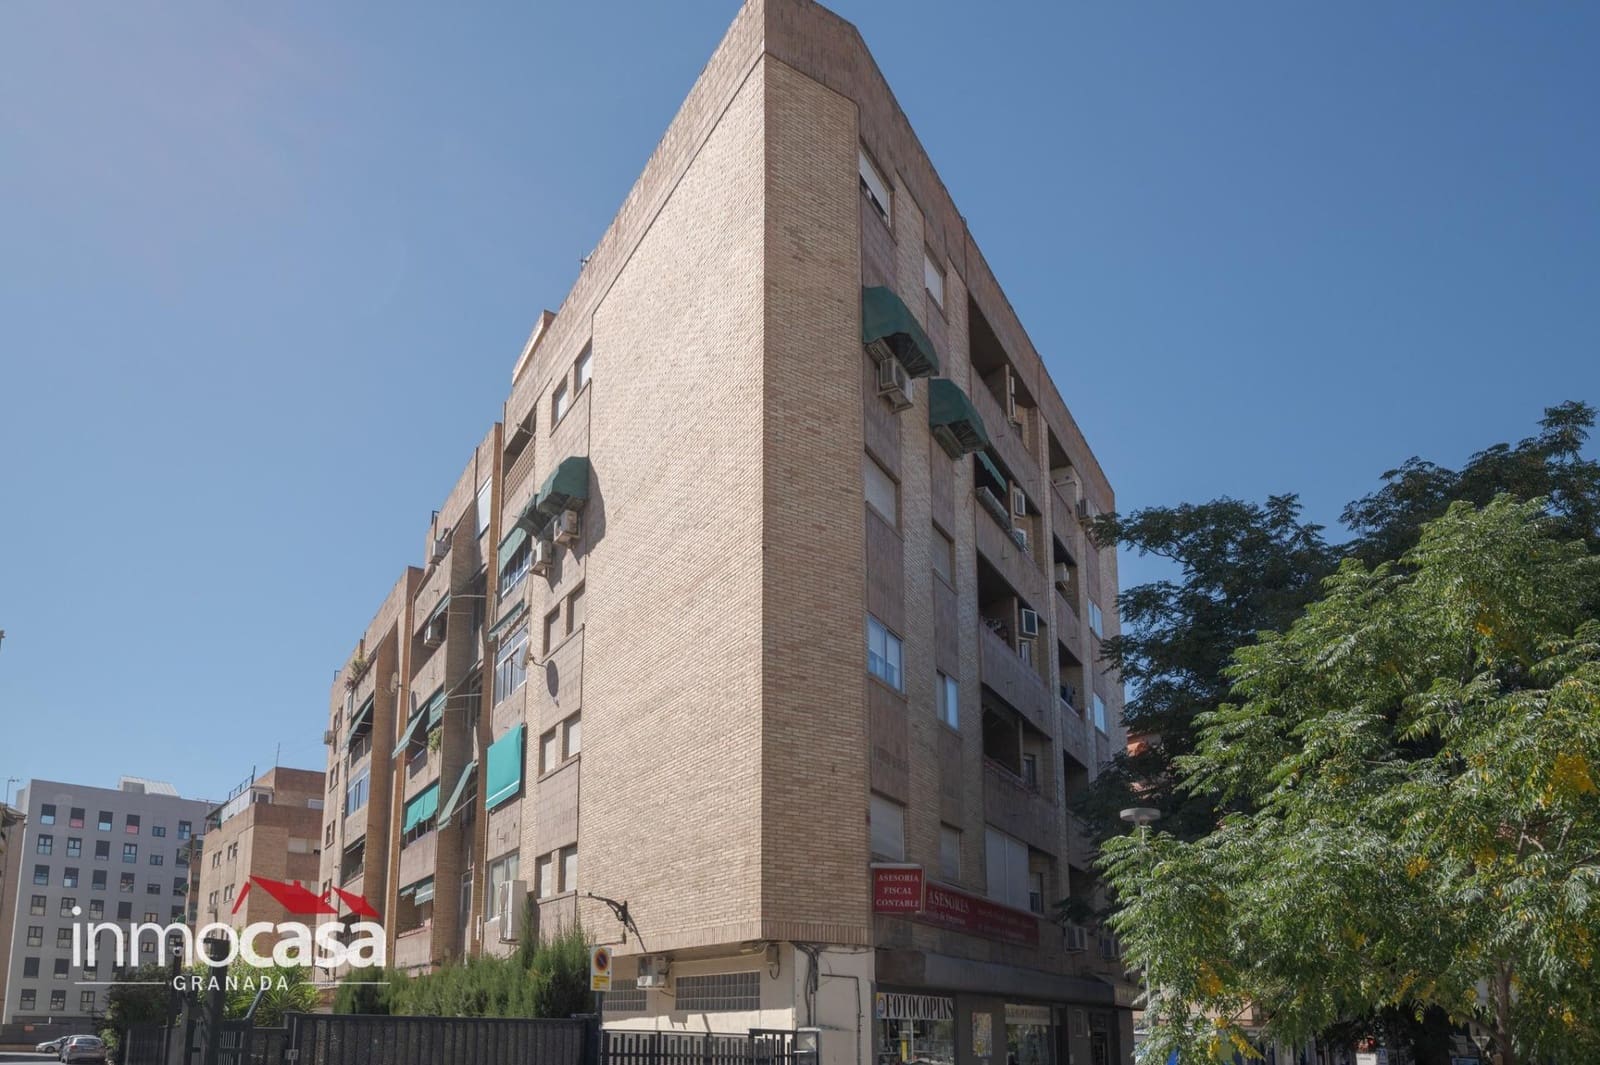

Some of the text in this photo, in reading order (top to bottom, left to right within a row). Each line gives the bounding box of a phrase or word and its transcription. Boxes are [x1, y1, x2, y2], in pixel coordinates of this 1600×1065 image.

[883, 887, 912, 895] FISCAL
[876, 898, 920, 907] CONTABLE
[927, 890, 970, 913] ASESORES
[885, 994, 954, 1019] FOTOCOPIAS
